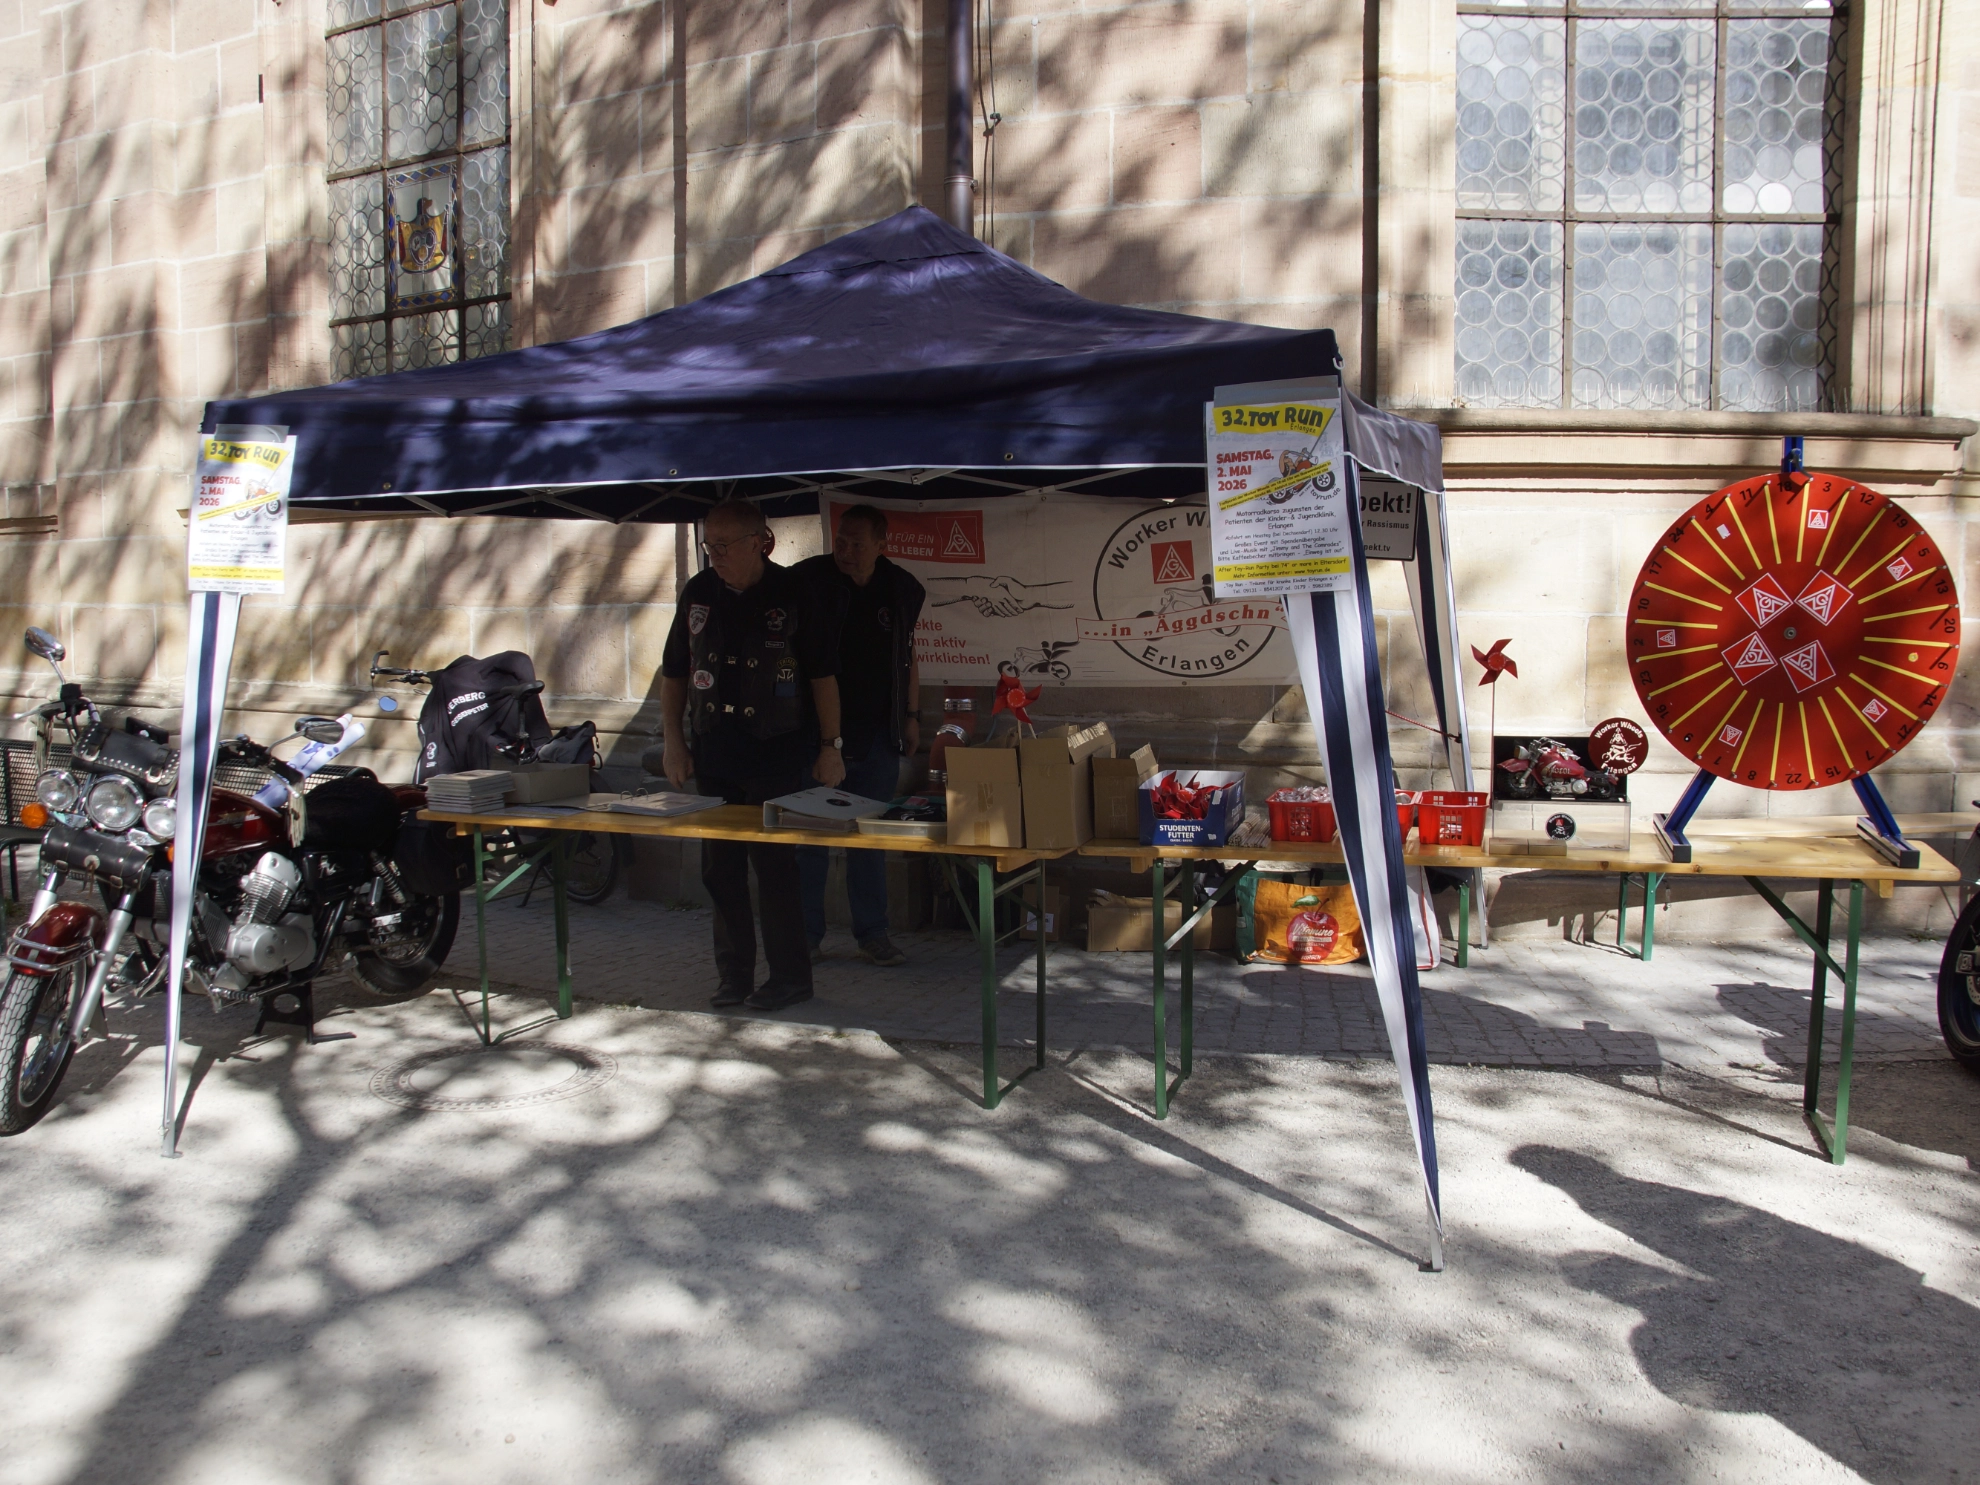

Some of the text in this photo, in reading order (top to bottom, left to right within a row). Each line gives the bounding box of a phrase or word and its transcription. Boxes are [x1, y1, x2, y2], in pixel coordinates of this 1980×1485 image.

[1285, 407, 1323, 427] Run
[1290, 423, 1316, 433] Erlangen
[254, 446, 280, 464] Run
[1216, 449, 1274, 464] SAMSTAG,
[1217, 465, 1252, 477] 2. MAI
[209, 487, 224, 495] MAI
[1218, 479, 1247, 491] 2026
[1777, 481, 1792, 492] 18
[1823, 482, 1832, 492] 3
[1310, 487, 1341, 500] toyrun.de
[1859, 492, 1875, 505] 12
[199, 498, 219, 506] 2026
[1236, 508, 1280, 517] Motorradkorso
[1282, 506, 1311, 515] zugunsten
[1705, 504, 1714, 515] 4
[1367, 520, 1409, 529] Rassismus
[1892, 514, 1908, 528] 19
[895, 532, 914, 542] FÜR
[917, 533, 934, 543] EIN
[1669, 527, 1684, 543] 24
[1108, 517, 1177, 569] Worker
[901, 544, 933, 556] LEBEN
[1232, 553, 1266, 561] Kaffeebecher
[1269, 551, 1295, 559] mitbringen
[1918, 548, 1931, 557] 5
[1649, 561, 1662, 575] 17
[1935, 579, 1949, 594] 13
[1638, 598, 1649, 610] 10
[1944, 618, 1956, 633] 20
[933, 636, 966, 648] aktiv
[1634, 638, 1644, 646] 2
[1142, 638, 1250, 671] Erlangen
[1640, 671, 1652, 685] 23
[1656, 704, 1669, 719] 16
[1594, 721, 1643, 738] Worker Wheels
[1866, 751, 1874, 761] 7
[1748, 770, 1757, 780] 8
[1826, 766, 1841, 778] 15
[1785, 773, 1802, 784] 22
